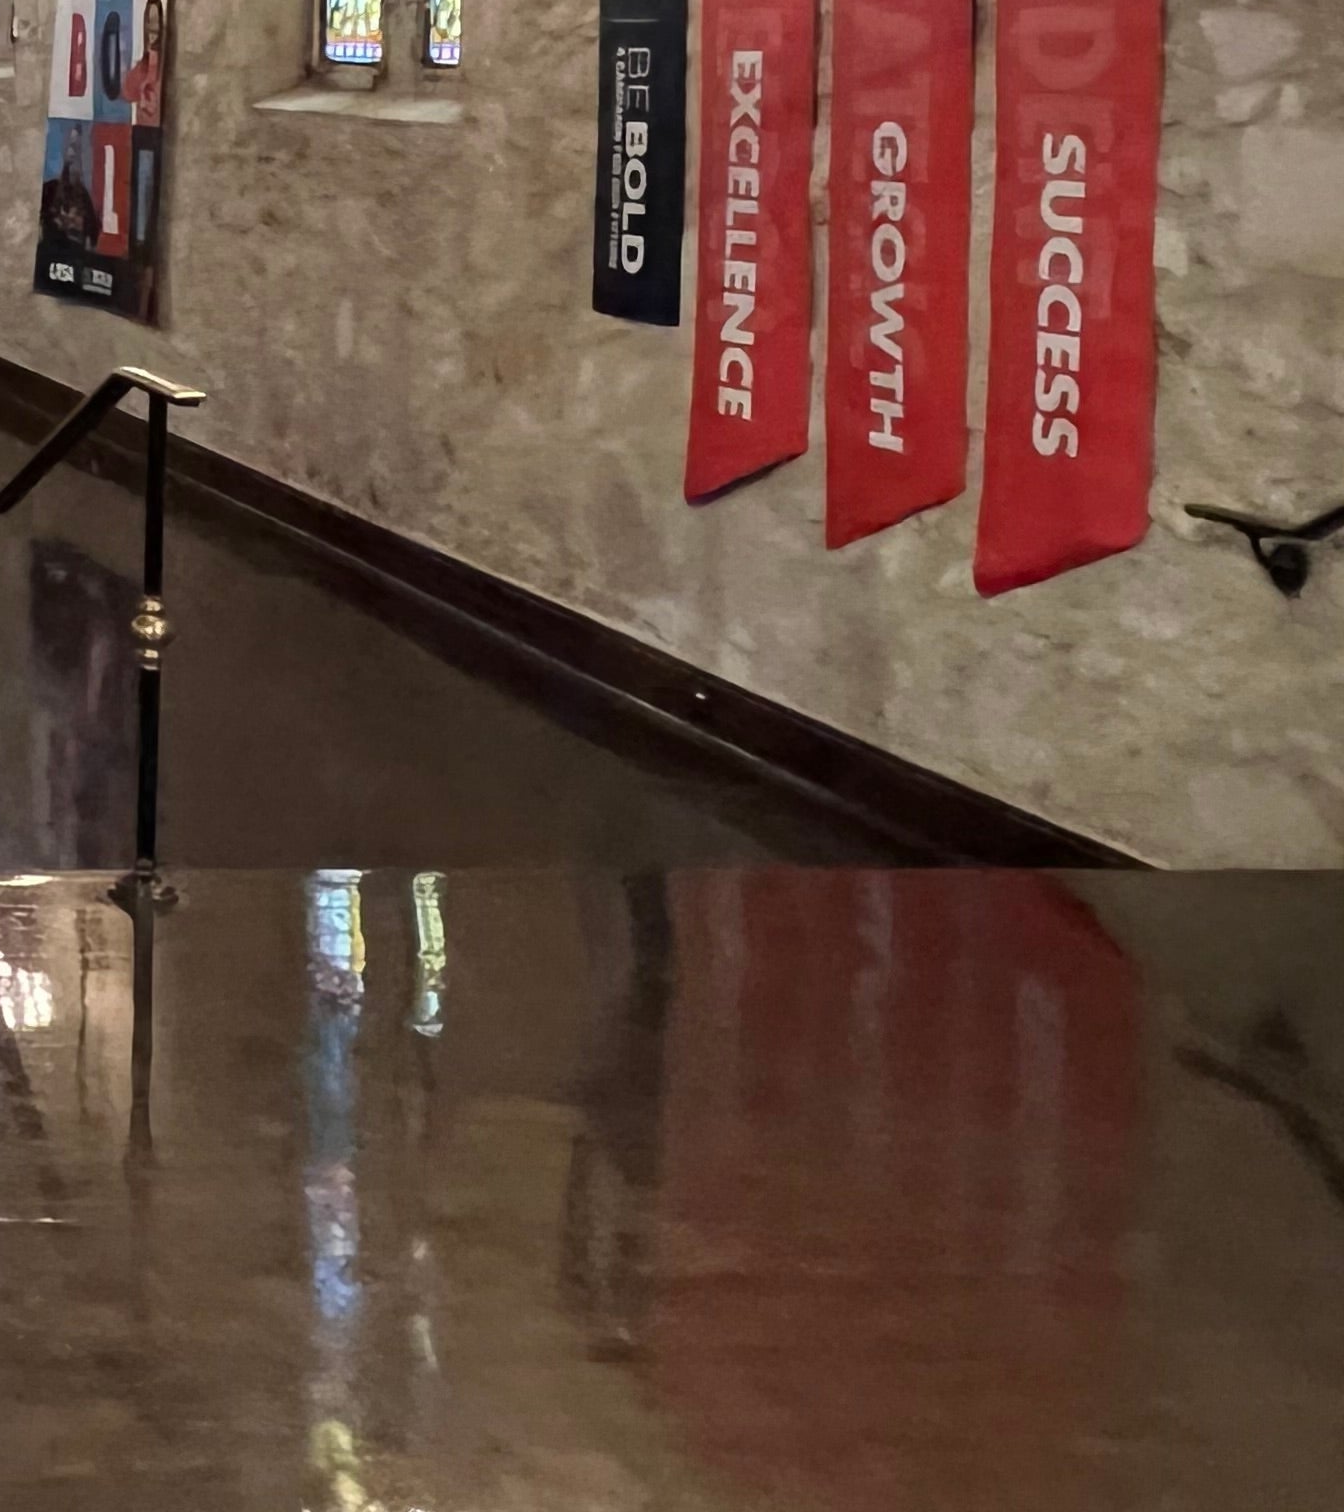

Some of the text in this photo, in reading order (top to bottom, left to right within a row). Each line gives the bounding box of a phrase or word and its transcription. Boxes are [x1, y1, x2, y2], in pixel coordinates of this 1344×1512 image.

[621, 48, 650, 274] BE BOLD
[717, 50, 762, 421] EXCELLENCE
[868, 121, 907, 455] GROWTH
[1031, 133, 1086, 459] SUCCESS
